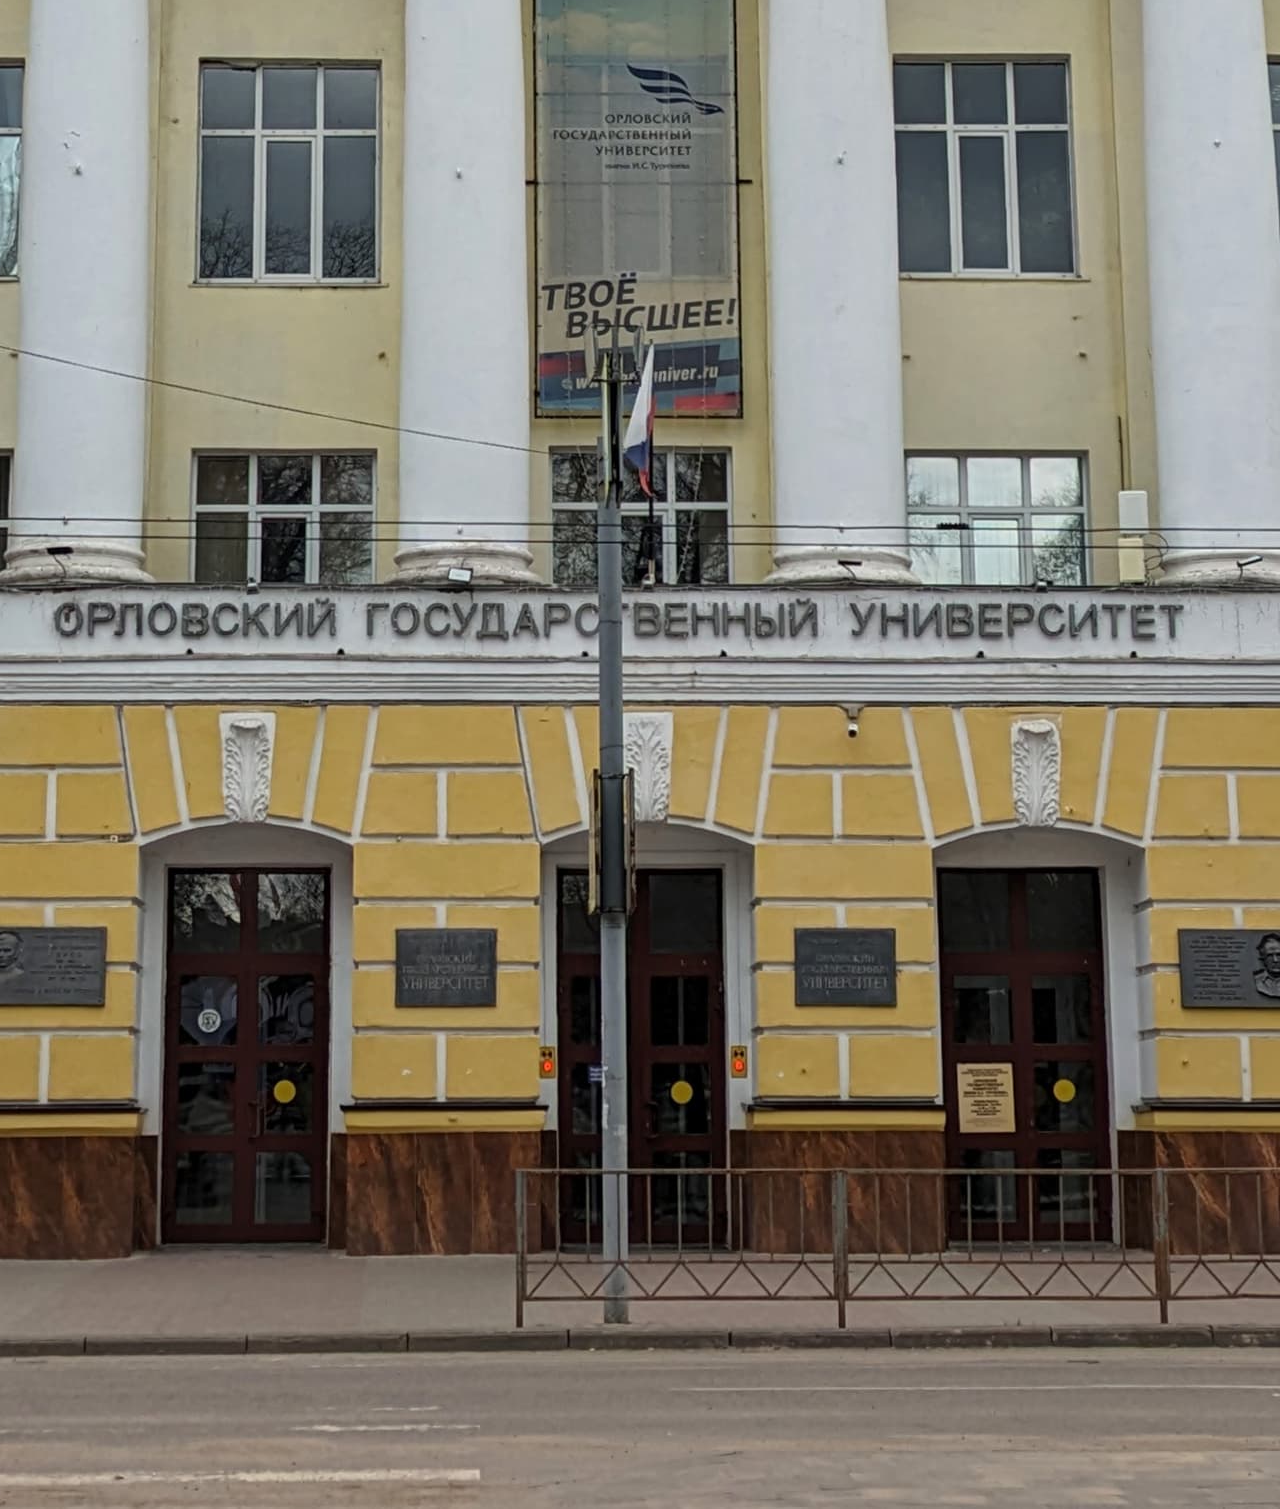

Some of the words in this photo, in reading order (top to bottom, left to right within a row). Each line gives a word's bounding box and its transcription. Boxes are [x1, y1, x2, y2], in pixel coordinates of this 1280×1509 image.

[604, 112, 692, 124] ОРЛОВСКИЙ
[553, 128, 692, 141] ГОСУДАРСТВЕННЫЙ
[595, 145, 692, 156] УНИВЕРСИТЕТ
[541, 272, 637, 311] ТВОЁ
[566, 298, 737, 338] ВЫСШЕЕ!
[53, 598, 337, 638] ОРЛОВСКИЙ
[365, 598, 819, 640] ГОСУДАРСВЕННЫЙ
[849, 601, 1185, 640] УНИВЕРСИТЕТ
